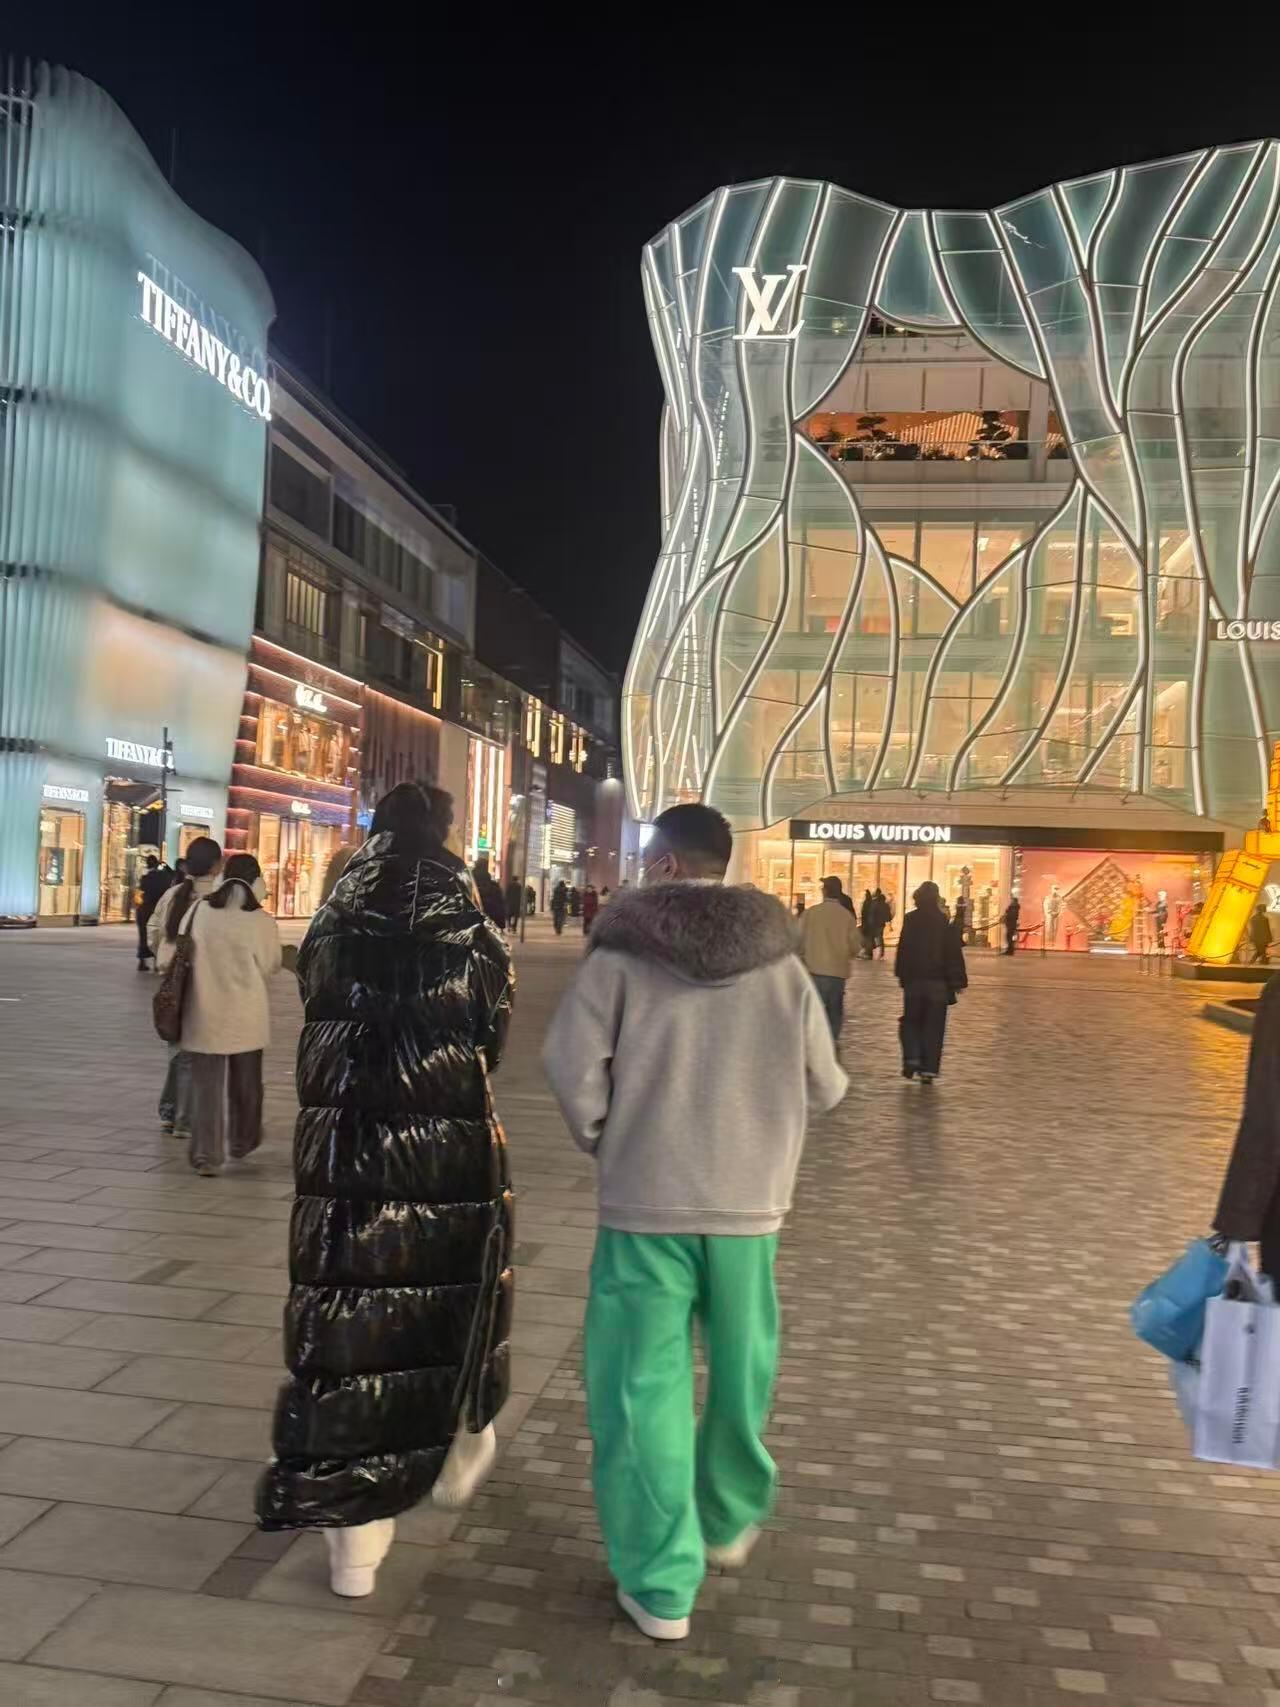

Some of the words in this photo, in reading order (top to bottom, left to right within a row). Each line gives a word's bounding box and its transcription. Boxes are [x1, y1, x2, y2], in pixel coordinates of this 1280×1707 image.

[1216, 620, 1280, 640] LOUIS
[809, 823, 865, 840] LOUIS
[868, 824, 951, 842] VUITTON
